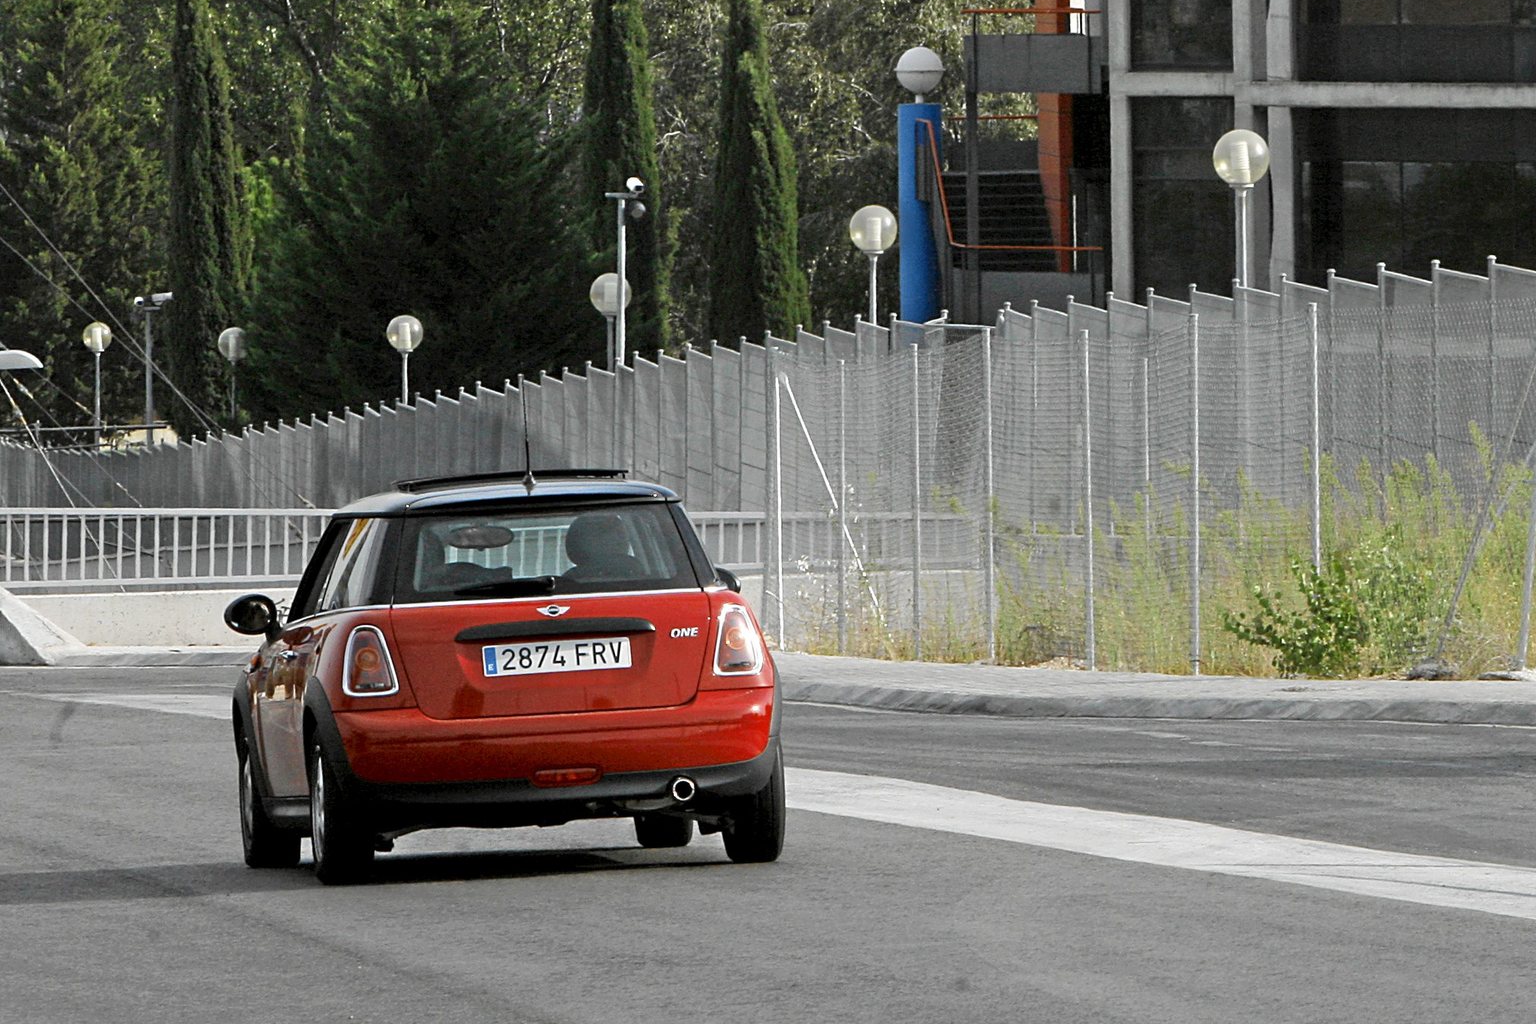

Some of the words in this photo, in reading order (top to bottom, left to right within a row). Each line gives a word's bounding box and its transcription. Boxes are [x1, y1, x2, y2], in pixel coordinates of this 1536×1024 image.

[670, 627, 699, 638] ONE
[501, 645, 566, 671] 2874
[575, 641, 622, 666] FRV
